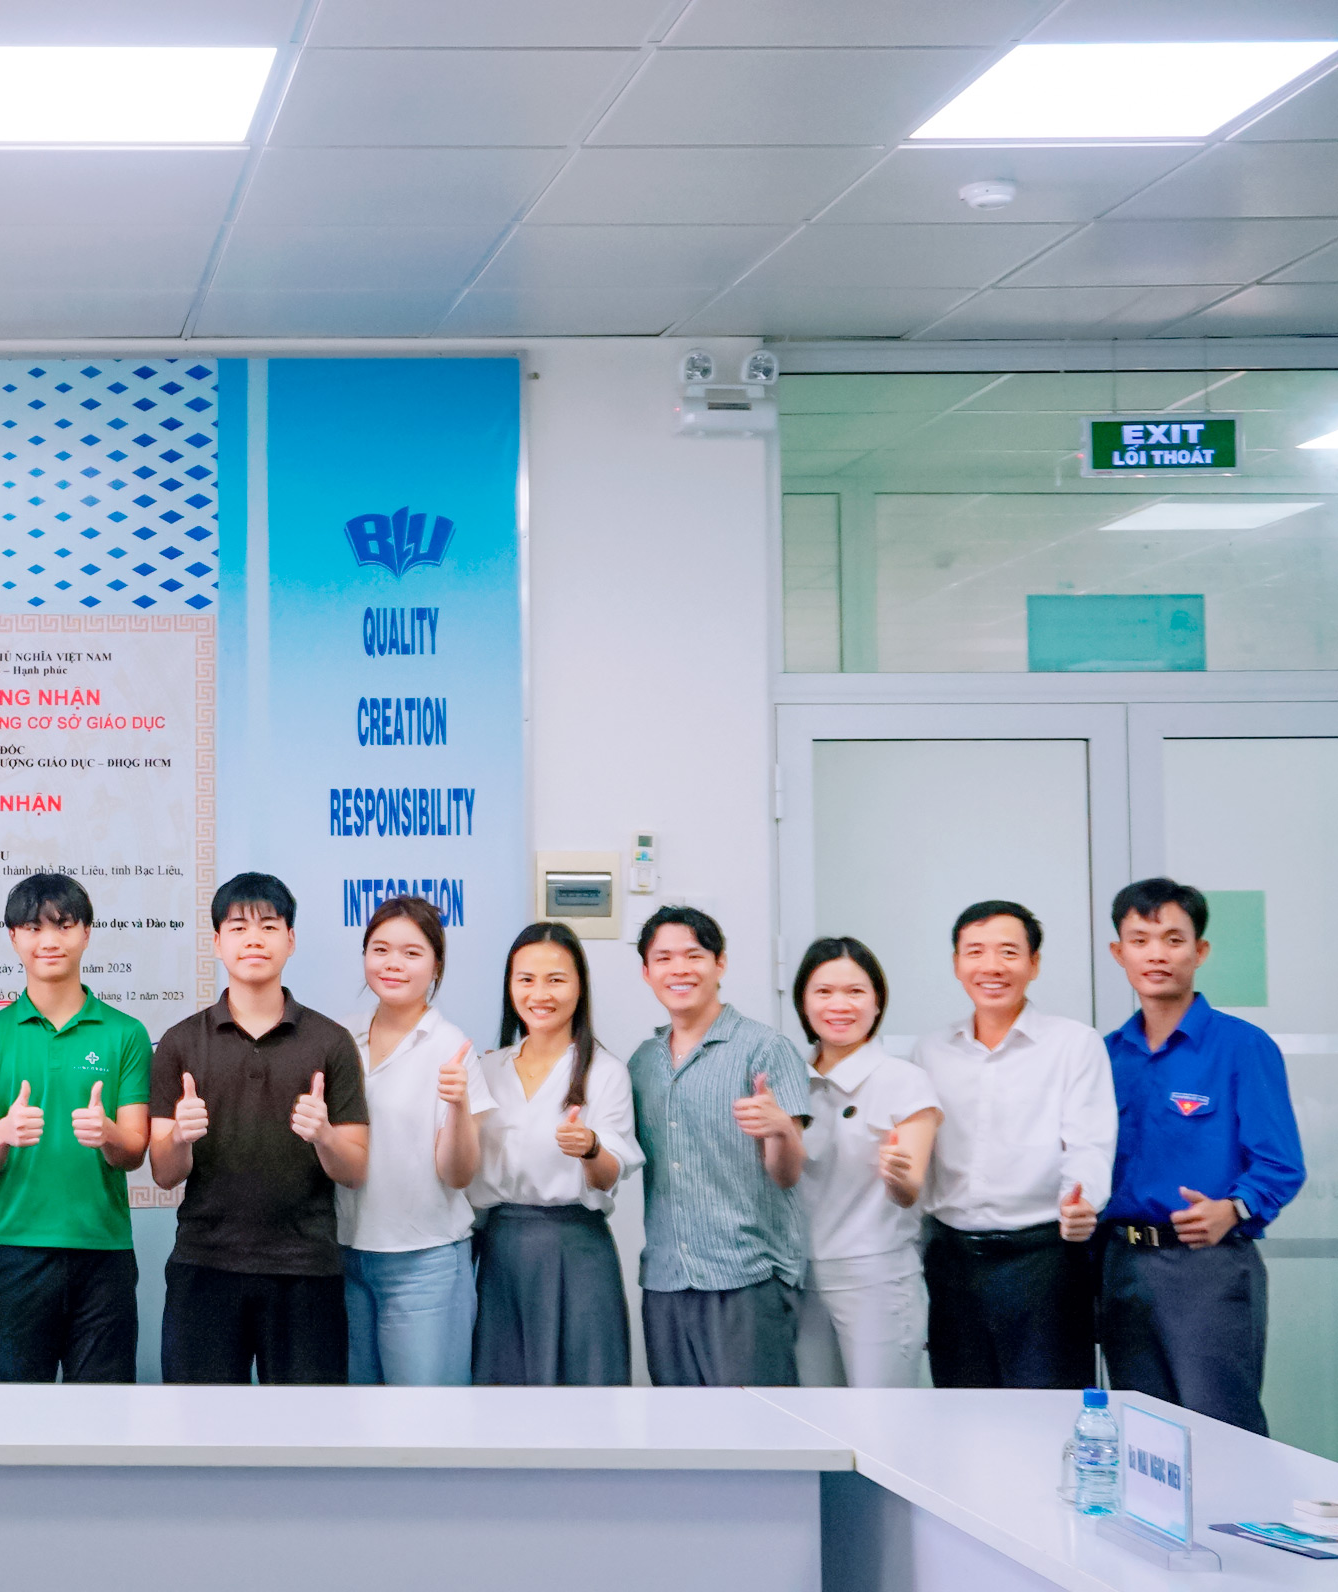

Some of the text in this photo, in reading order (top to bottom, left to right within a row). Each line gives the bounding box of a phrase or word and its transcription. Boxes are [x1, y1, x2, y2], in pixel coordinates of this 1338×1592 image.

[1122, 423, 1205, 445] EXIT
[1113, 444, 1215, 466] LỐI THOÁT
[363, 607, 440, 659] QUALITY
[15, 650, 53, 662] NGHĨA
[56, 651, 81, 664] VIỆT
[86, 652, 112, 662] NAM
[38, 686, 101, 711] NHẬN
[27, 716, 53, 730] CƠ
[56, 713, 82, 730] SỞ
[86, 713, 127, 730] GIÁO
[132, 715, 166, 733] DỤC
[357, 696, 447, 747] CREATION
[145, 758, 171, 768] HCM
[0, 792, 62, 817] NHẬN
[329, 786, 476, 838] RESPONSIBILITY
[82, 962, 132, 974] năm 2028
[97, 990, 185, 1002] tháng 12 năm 2023
